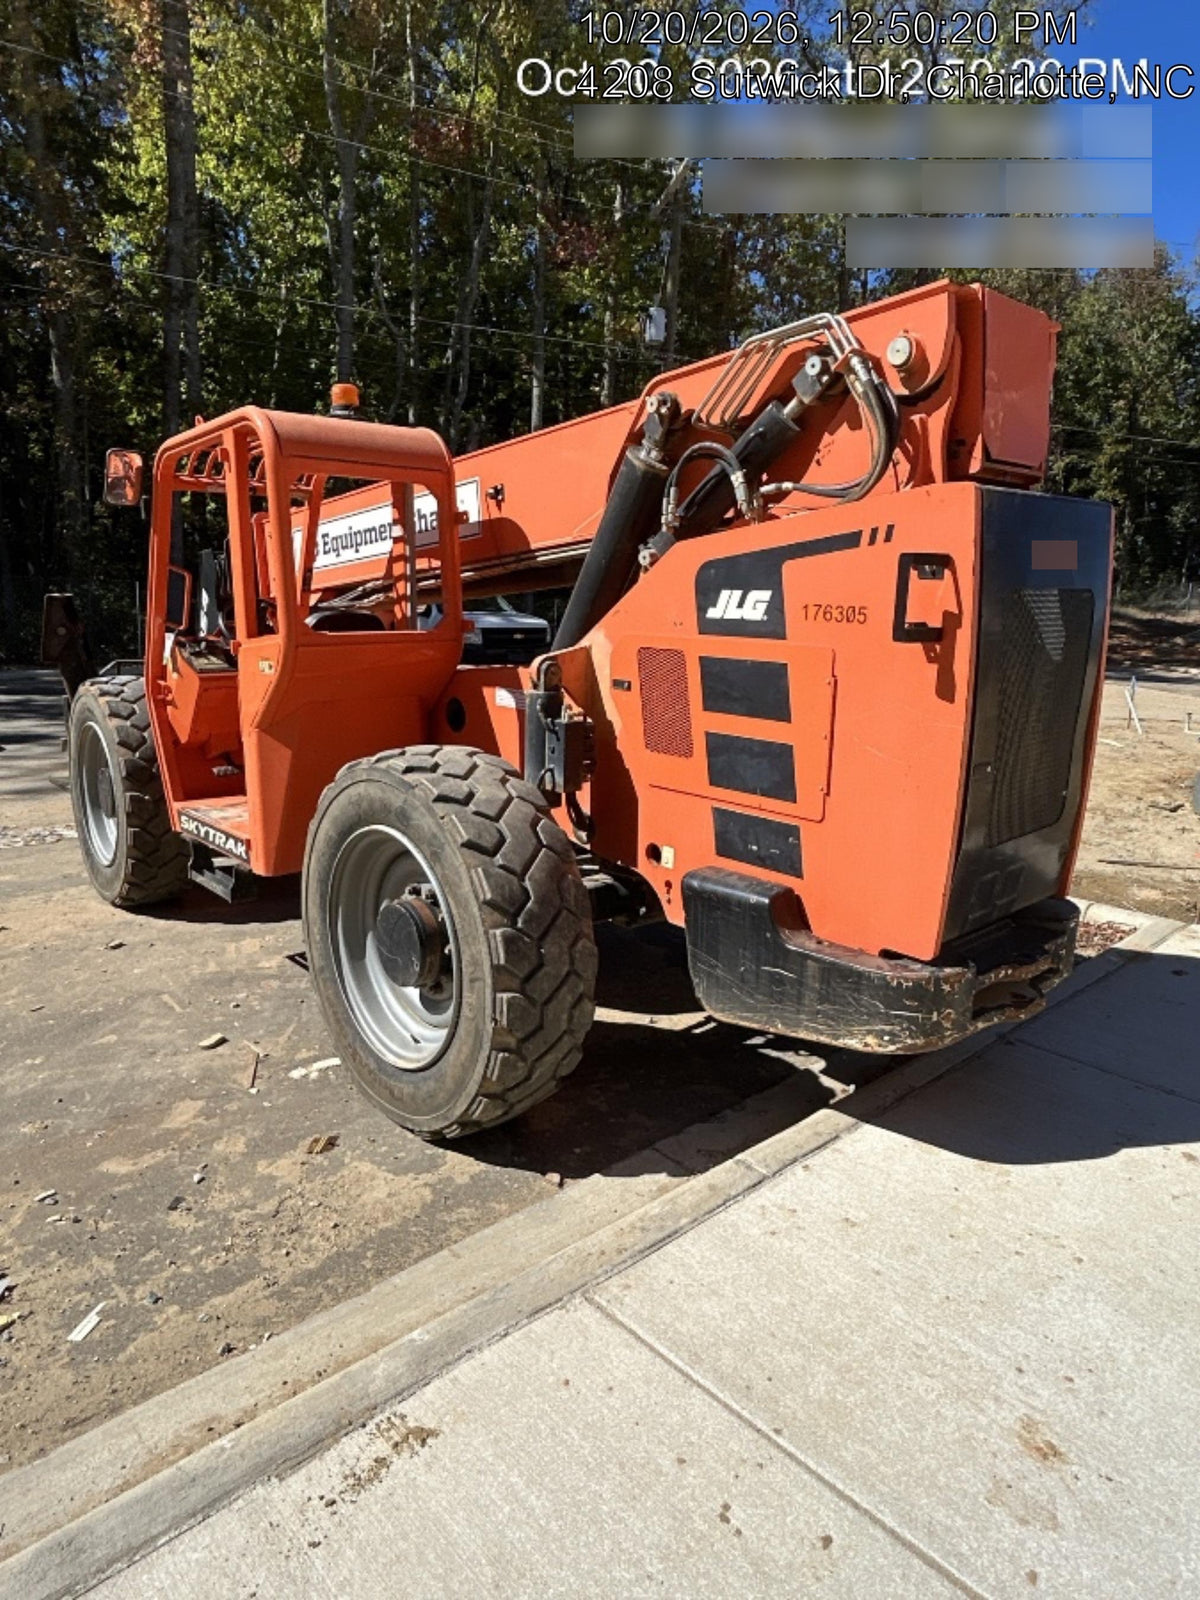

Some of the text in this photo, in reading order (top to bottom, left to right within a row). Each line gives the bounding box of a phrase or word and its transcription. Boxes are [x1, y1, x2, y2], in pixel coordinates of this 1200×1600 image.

[705, 589, 773, 621] JLG
[802, 603, 868, 625] 176305
[180, 815, 247, 859] SKYTRAK
